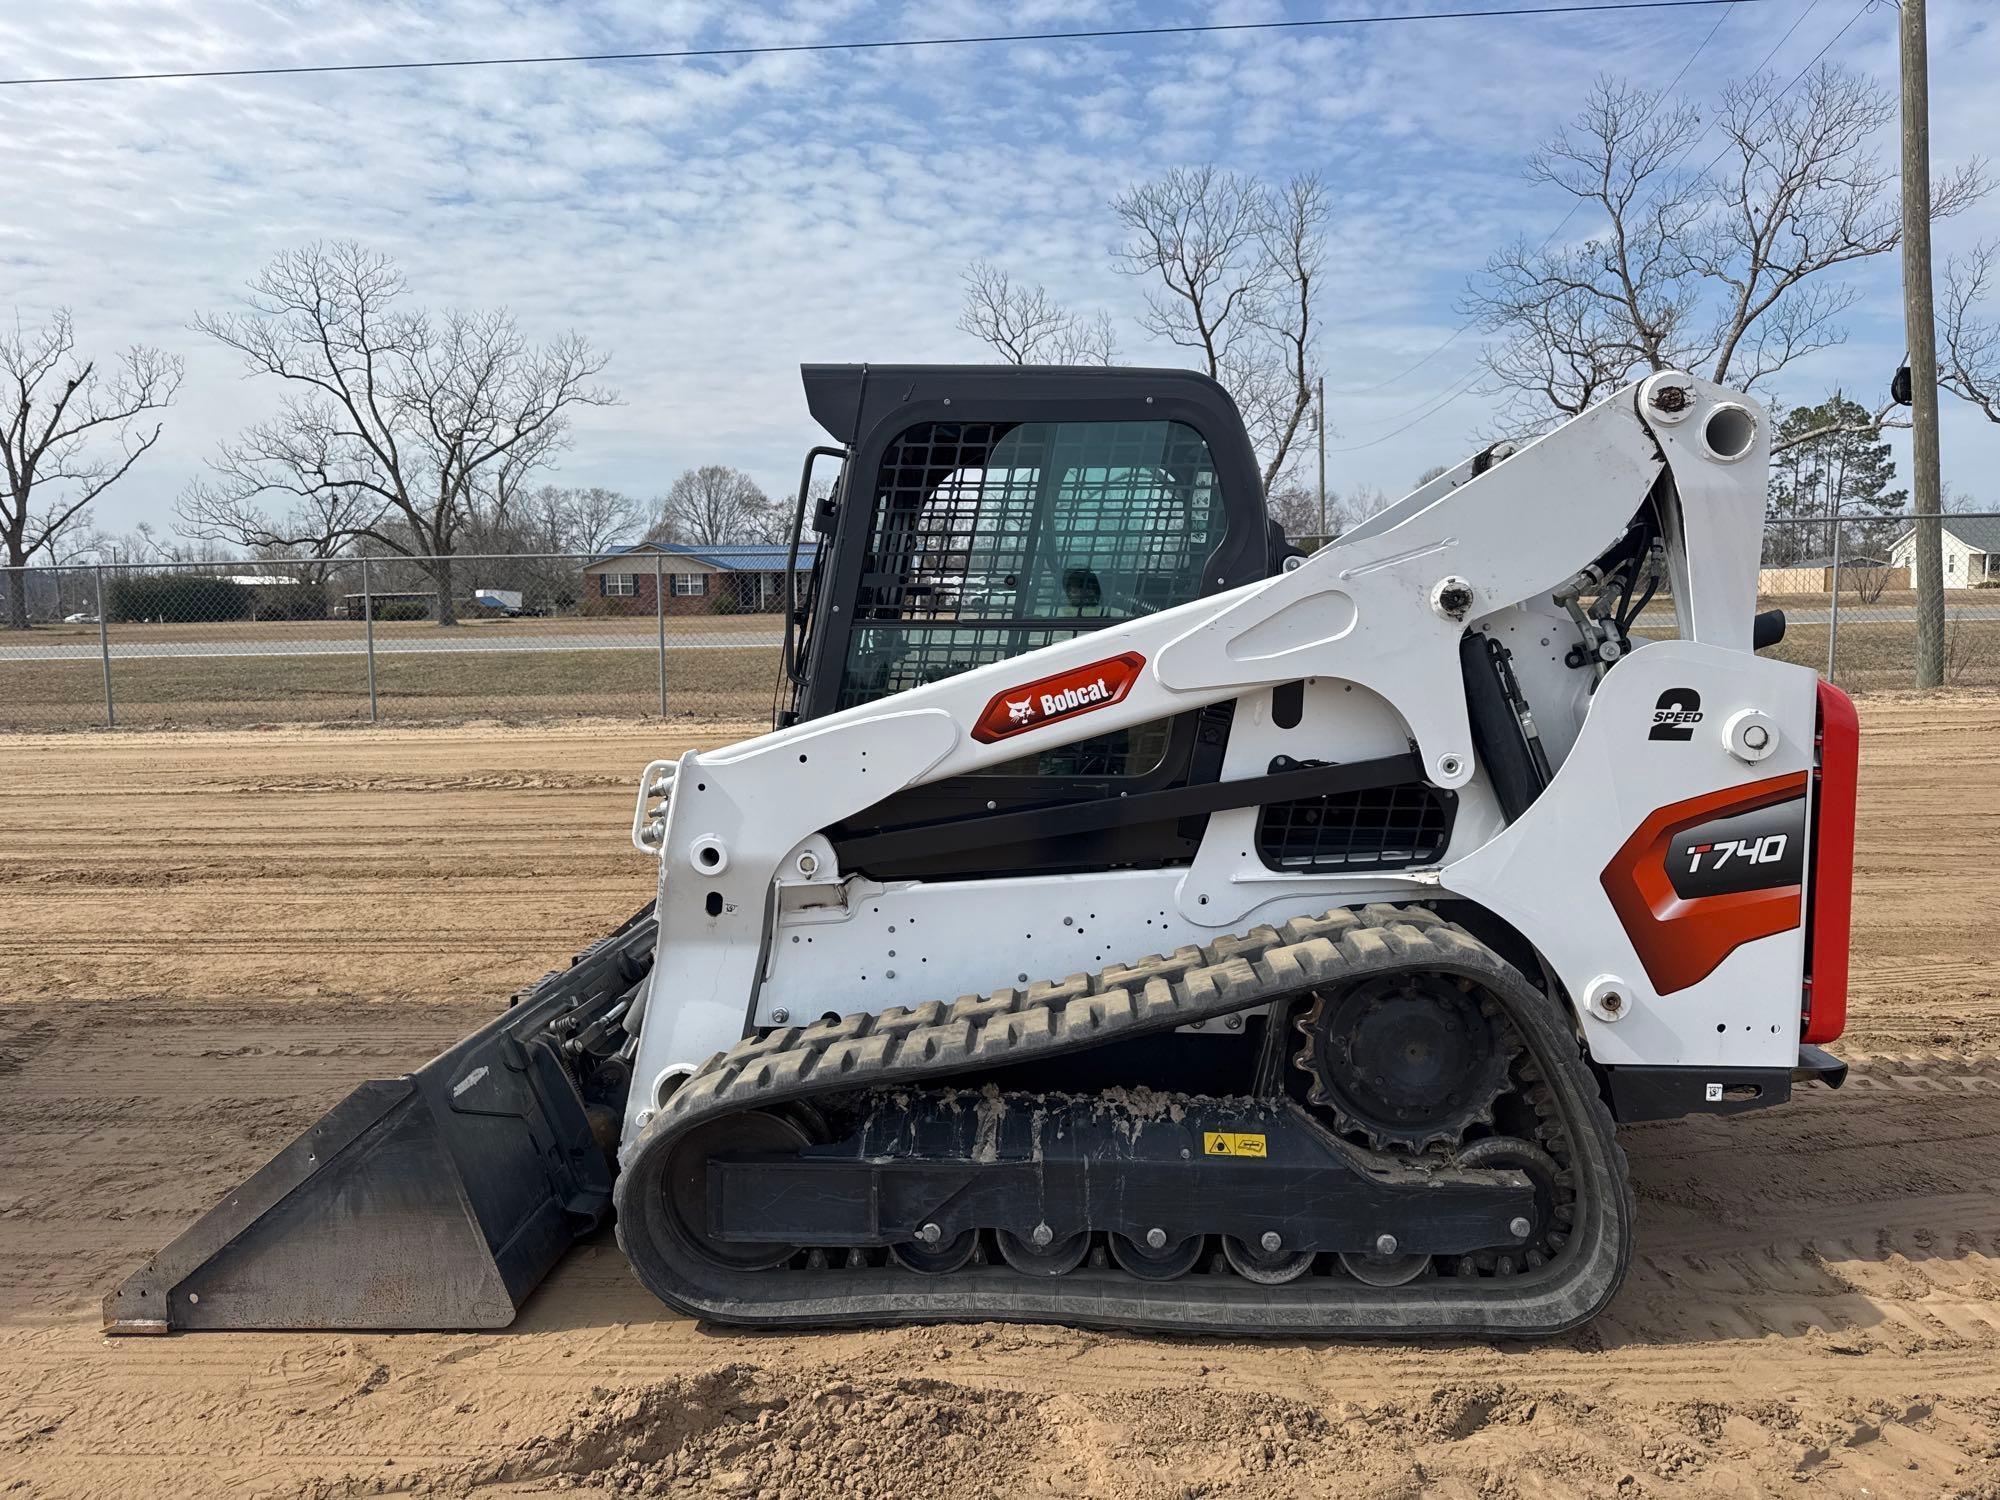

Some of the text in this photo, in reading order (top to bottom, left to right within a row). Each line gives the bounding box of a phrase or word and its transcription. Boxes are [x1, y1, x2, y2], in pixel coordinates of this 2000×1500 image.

[1040, 678, 1109, 716] Bobcat
[1648, 687, 1701, 741] 2
[1652, 711, 1703, 723] SPEED
[1686, 834, 1788, 873] T740
